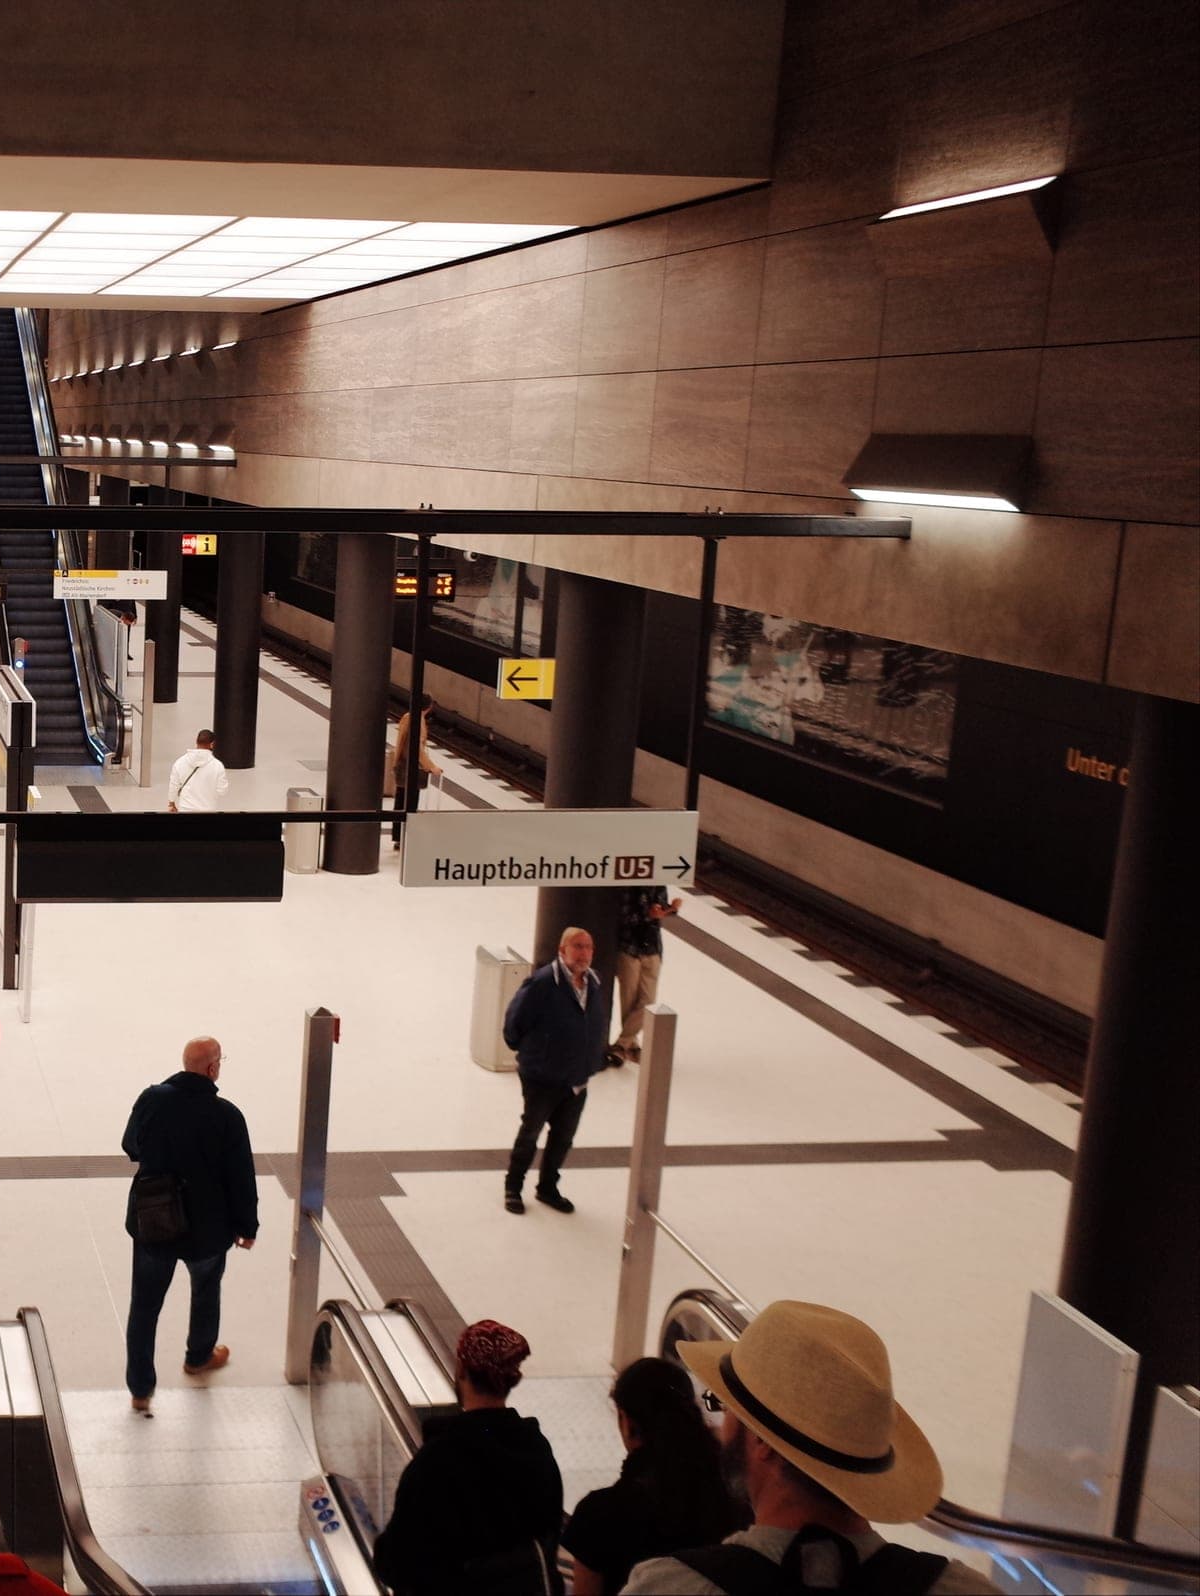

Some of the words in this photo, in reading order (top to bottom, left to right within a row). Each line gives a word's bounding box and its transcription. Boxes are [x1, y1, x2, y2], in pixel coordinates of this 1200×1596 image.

[1066, 747, 1116, 782] Unter
[435, 855, 609, 886] Hauptbahnhof
[616, 856, 653, 879] U5
